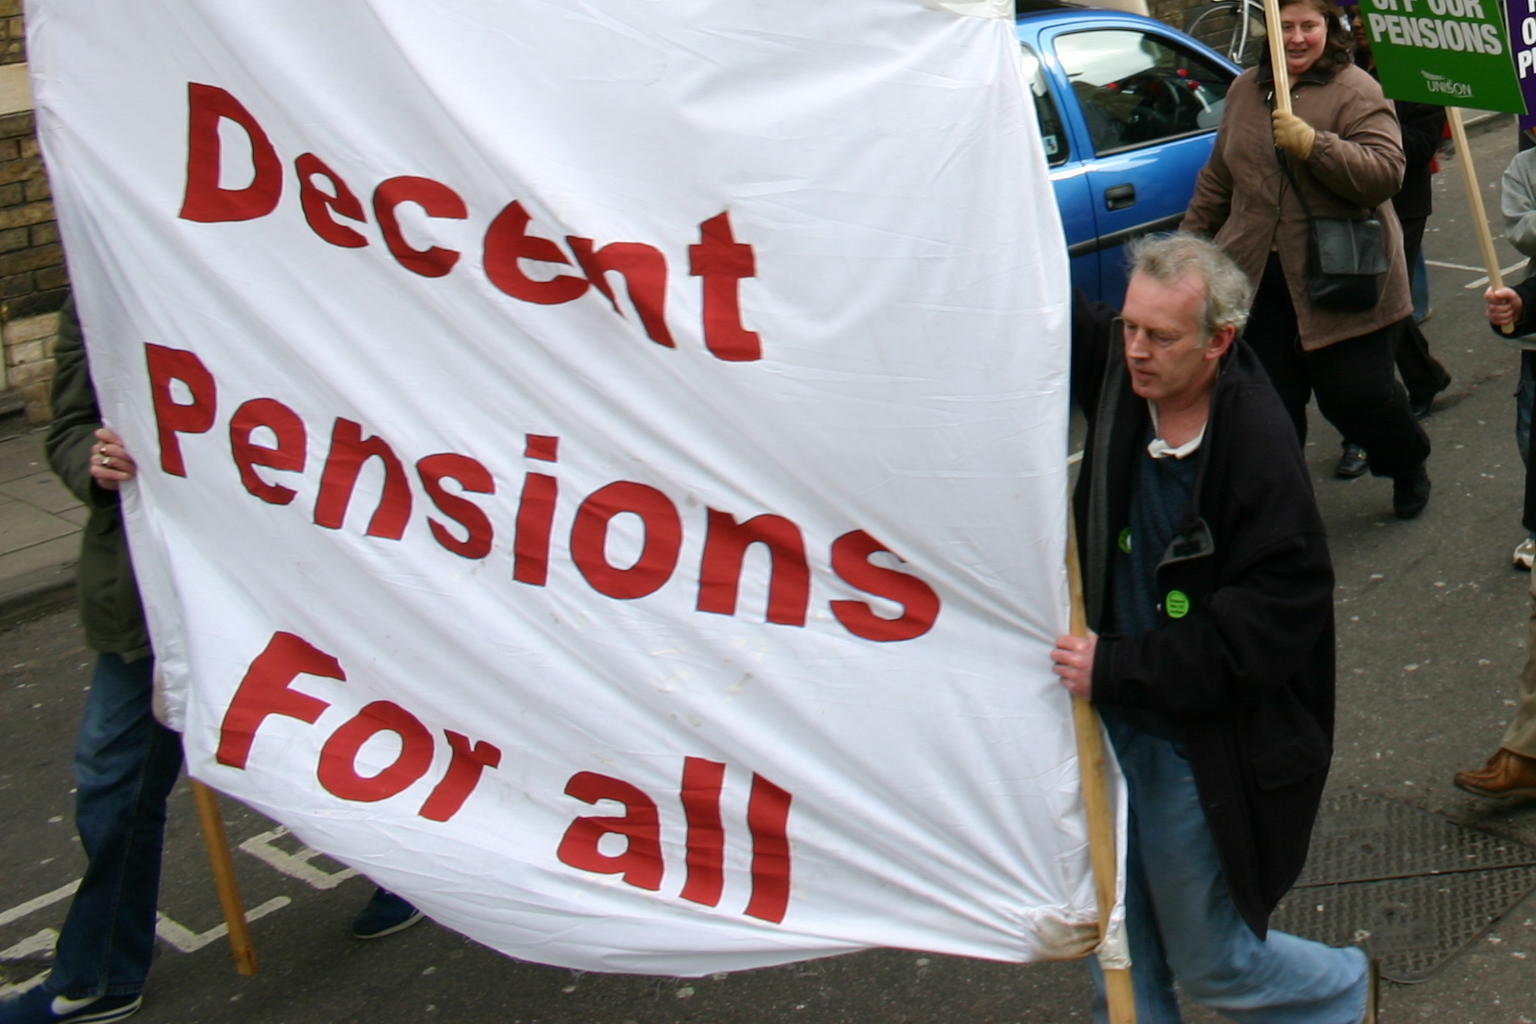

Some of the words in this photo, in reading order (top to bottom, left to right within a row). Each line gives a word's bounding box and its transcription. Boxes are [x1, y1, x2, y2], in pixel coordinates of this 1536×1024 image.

[1367, 13, 1503, 56] PENSIONS
[1426, 79, 1473, 97] UNISON
[178, 82, 763, 362] Decent
[144, 342, 941, 643] Pensions
[216, 631, 501, 822] For
[556, 756, 791, 924] all
